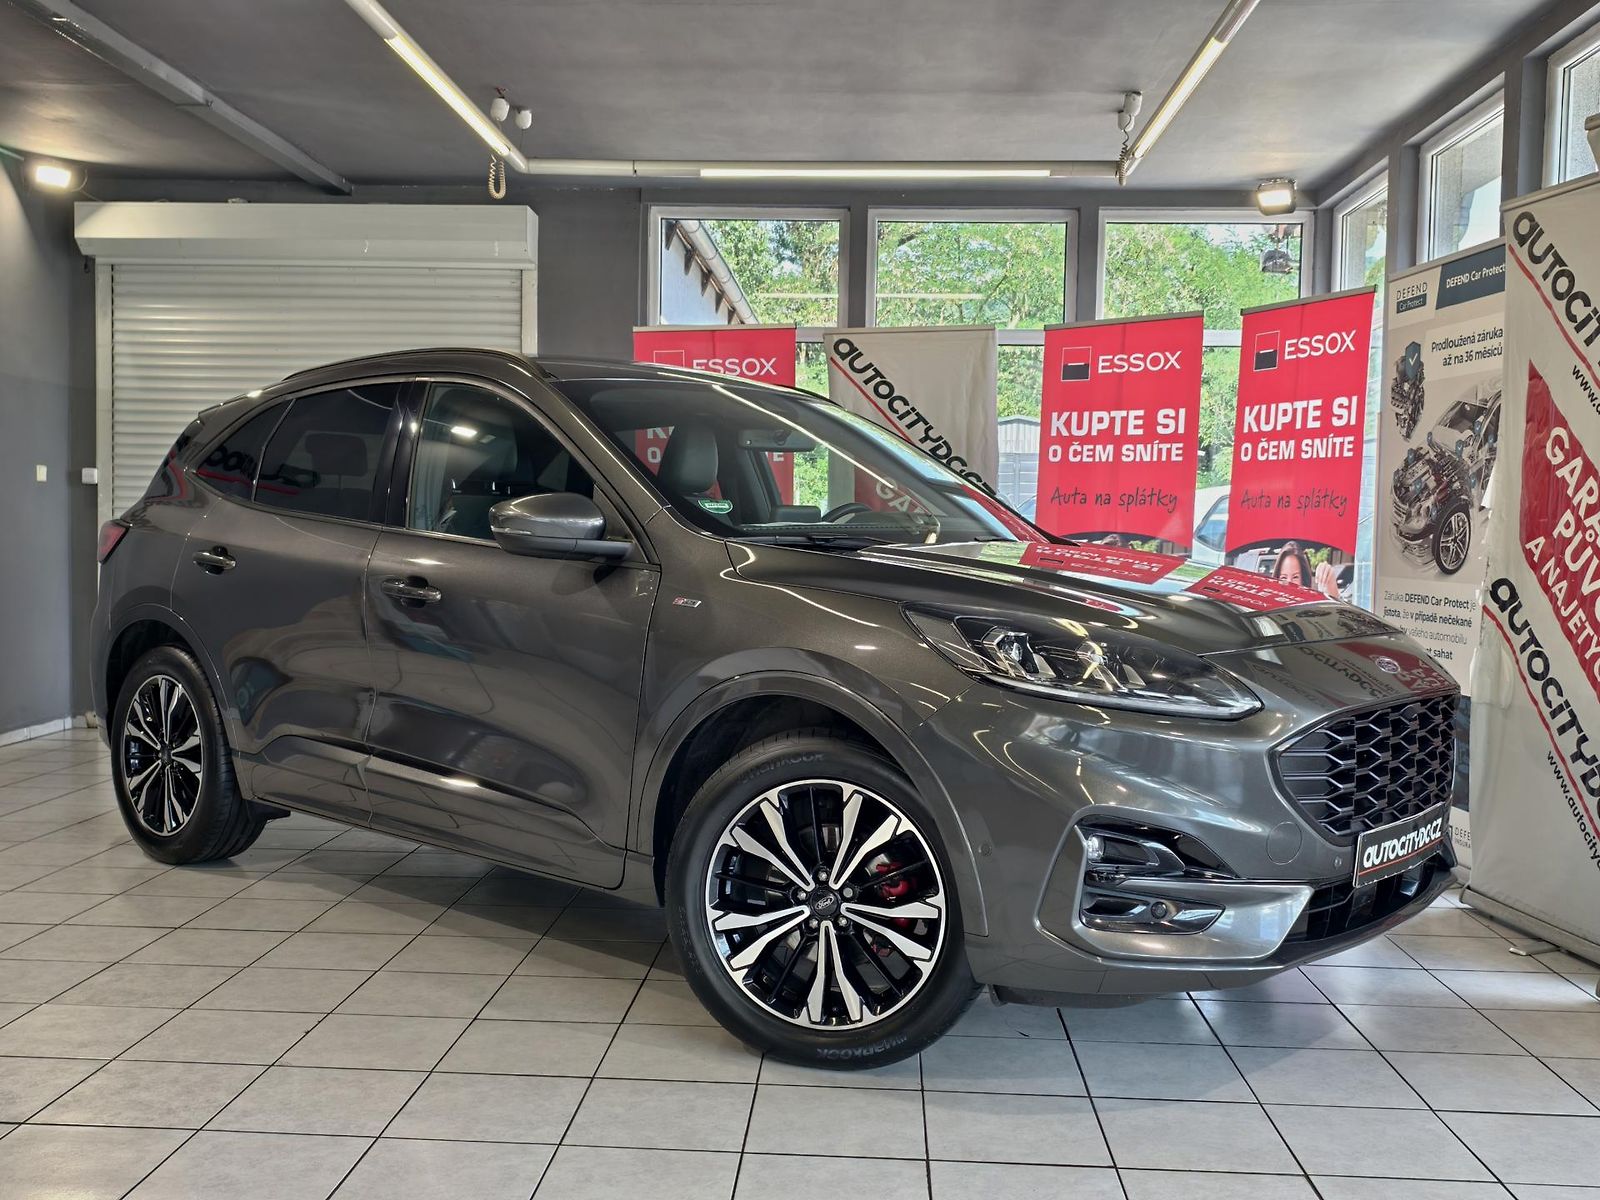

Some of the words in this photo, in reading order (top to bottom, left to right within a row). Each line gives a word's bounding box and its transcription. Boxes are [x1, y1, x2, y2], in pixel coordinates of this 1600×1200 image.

[1446, 273, 1470, 288] DEFEND
[1470, 271, 1481, 281] Car
[1482, 264, 1506, 278] Protect
[1397, 282, 1427, 300] DEFEND
[1284, 330, 1356, 361] ESSOX
[1431, 332, 1475, 352] Prodloužená
[1477, 327, 1503, 343] záruka
[1098, 350, 1182, 374] ESSOX
[1443, 354, 1452, 366] až
[1454, 355, 1464, 365] na
[1465, 350, 1473, 362] 36
[1475, 342, 1503, 360] měsíců
[692, 357, 777, 376] ESSOX
[1050, 409, 1145, 437] KUPTE
[1156, 407, 1186, 434] SI
[1243, 399, 1322, 433] KUPTE
[1332, 395, 1358, 427] SI
[1048, 445, 1062, 463] O
[1068, 440, 1113, 463] ČEM
[1121, 438, 1184, 462] SNÍTE
[1240, 444, 1252, 462] O
[1258, 437, 1295, 461] ČEM
[1300, 433, 1355, 459] SNÍTE
[1051, 487, 1087, 506] Auta
[1095, 492, 1111, 506] na
[1118, 487, 1178, 514] splátky
[1240, 489, 1271, 509] Auta
[1277, 495, 1291, 509] na
[1296, 488, 1348, 517] splátky
[1525, 536, 1546, 563] A
[1404, 593, 1429, 605] DEFEND
[1431, 596, 1442, 606] Car
[1443, 597, 1469, 609] Protect
[1415, 610, 1438, 623] případě
[1439, 615, 1472, 627] nečekané
[1429, 630, 1467, 645] automobilu
[1433, 649, 1453, 660] sahat
